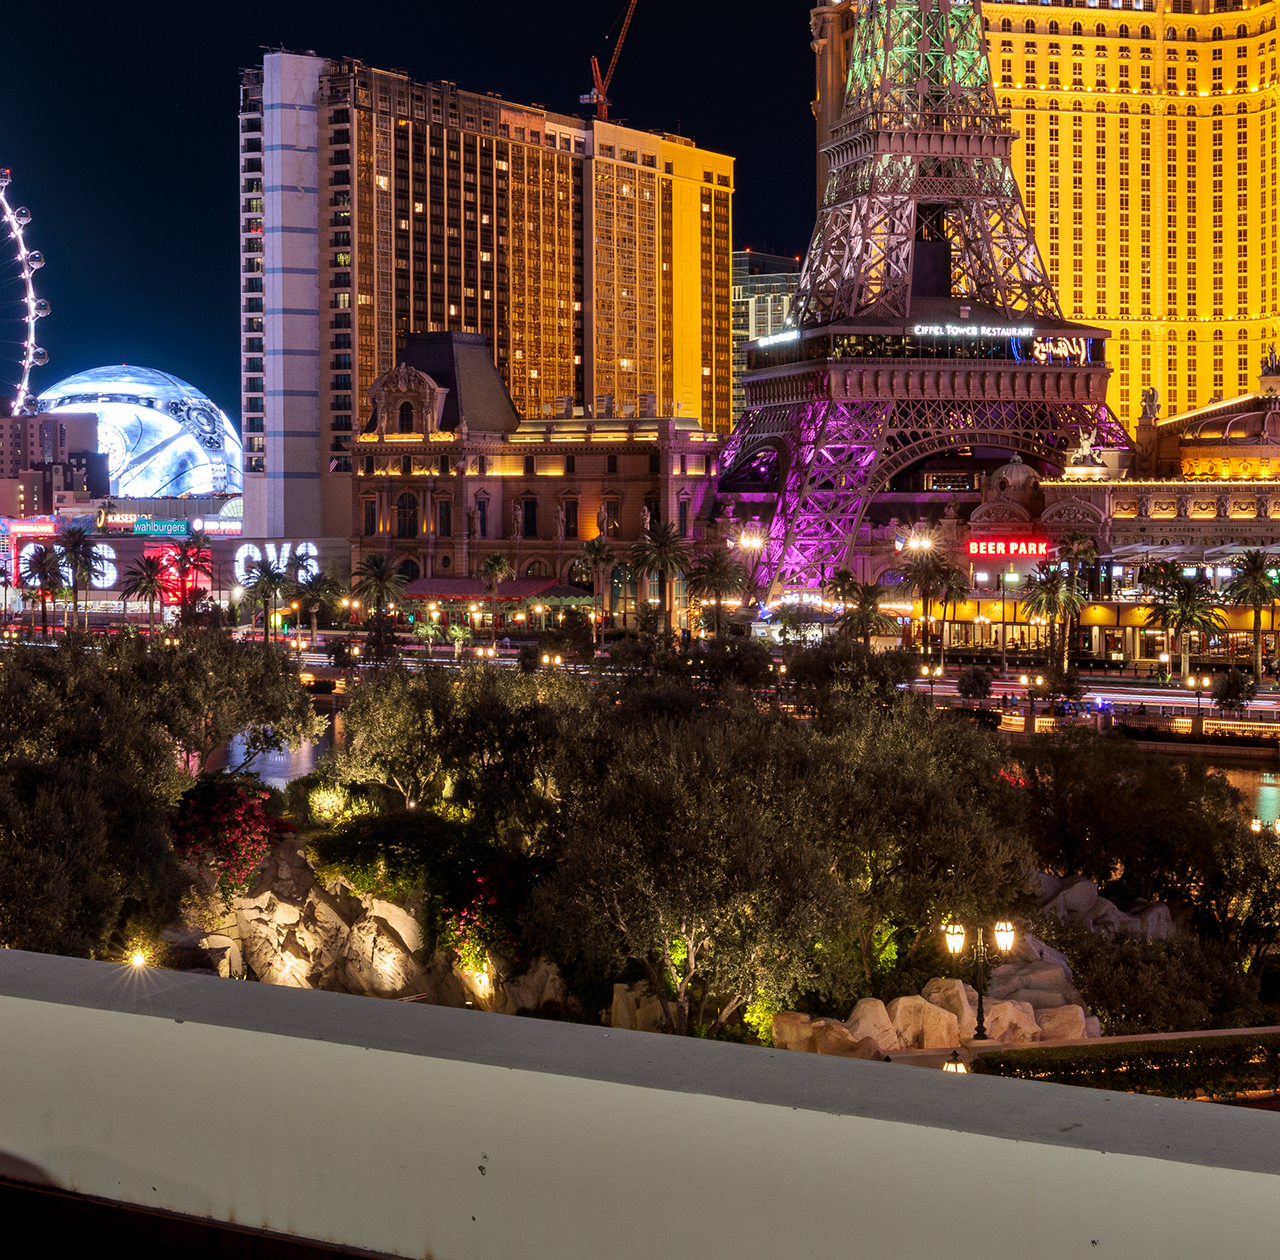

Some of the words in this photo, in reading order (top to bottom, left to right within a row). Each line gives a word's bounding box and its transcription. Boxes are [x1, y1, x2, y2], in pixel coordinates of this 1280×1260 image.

[913, 325, 945, 336] EIFFEL
[946, 325, 978, 336] TOWER
[980, 326, 1034, 337] RESTAURANT
[134, 522, 186, 534] wahlburgers
[969, 541, 1006, 555] BEER
[1009, 541, 1048, 555] PARK
[234, 542, 320, 587] CVS
